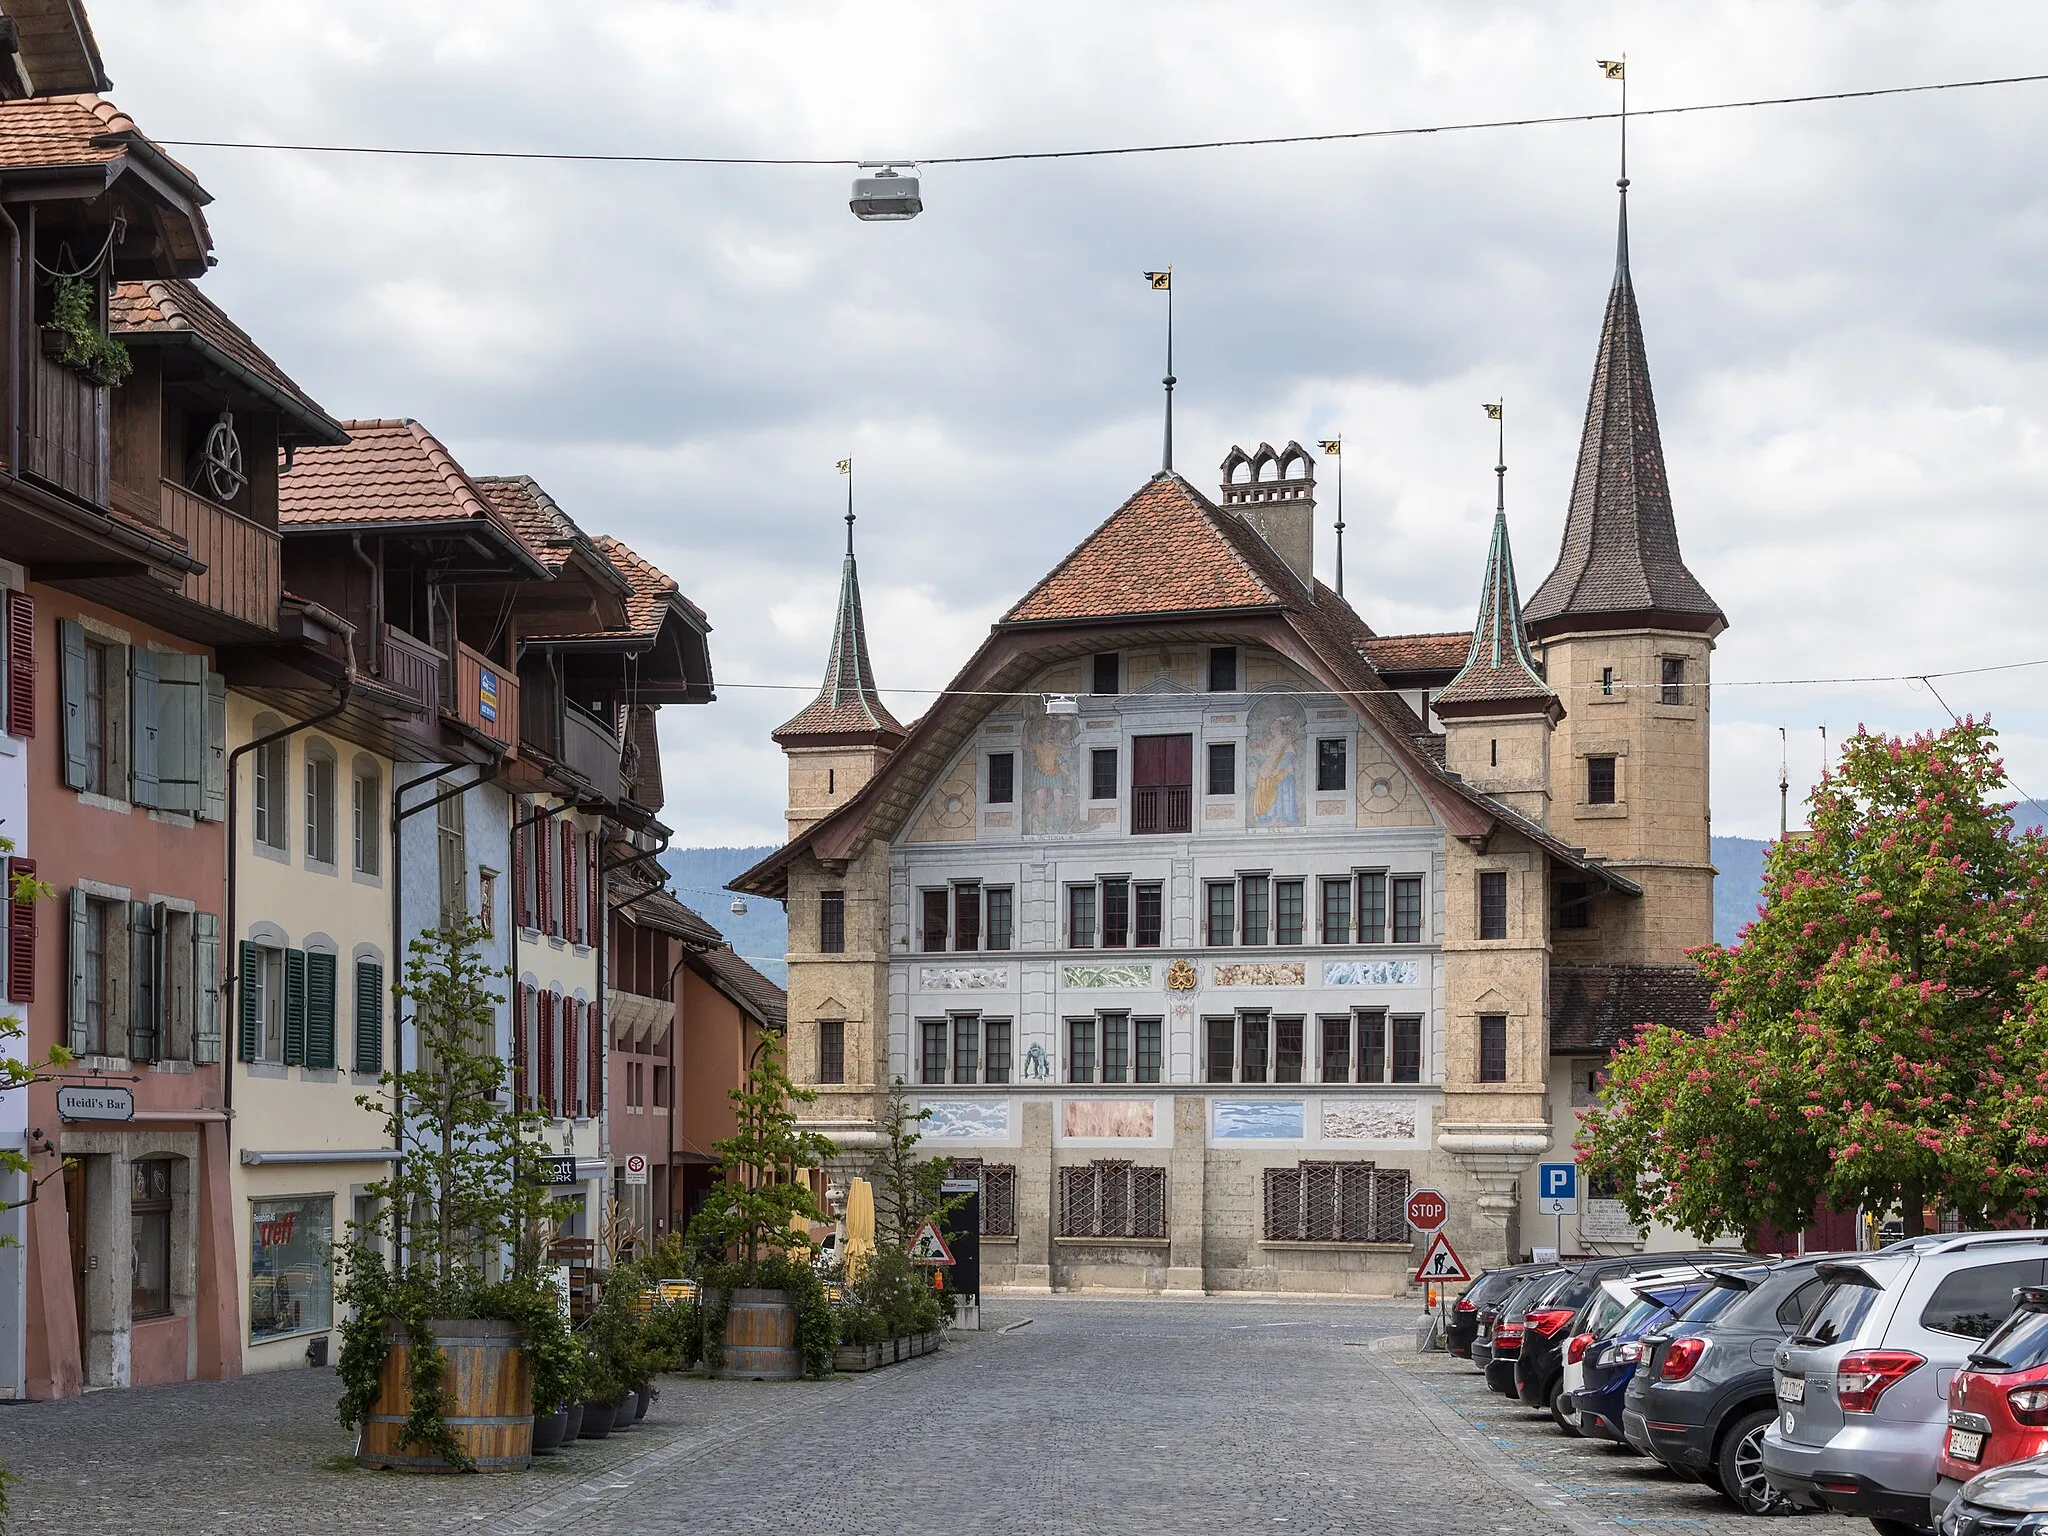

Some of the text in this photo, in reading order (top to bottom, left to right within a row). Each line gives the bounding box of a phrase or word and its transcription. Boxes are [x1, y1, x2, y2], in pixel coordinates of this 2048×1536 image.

[66, 1097, 126, 1110] Heidi's Bar
[1550, 1169, 1567, 1195] P
[1411, 1204, 1442, 1218] STOP
[261, 1211, 296, 1248] treff
